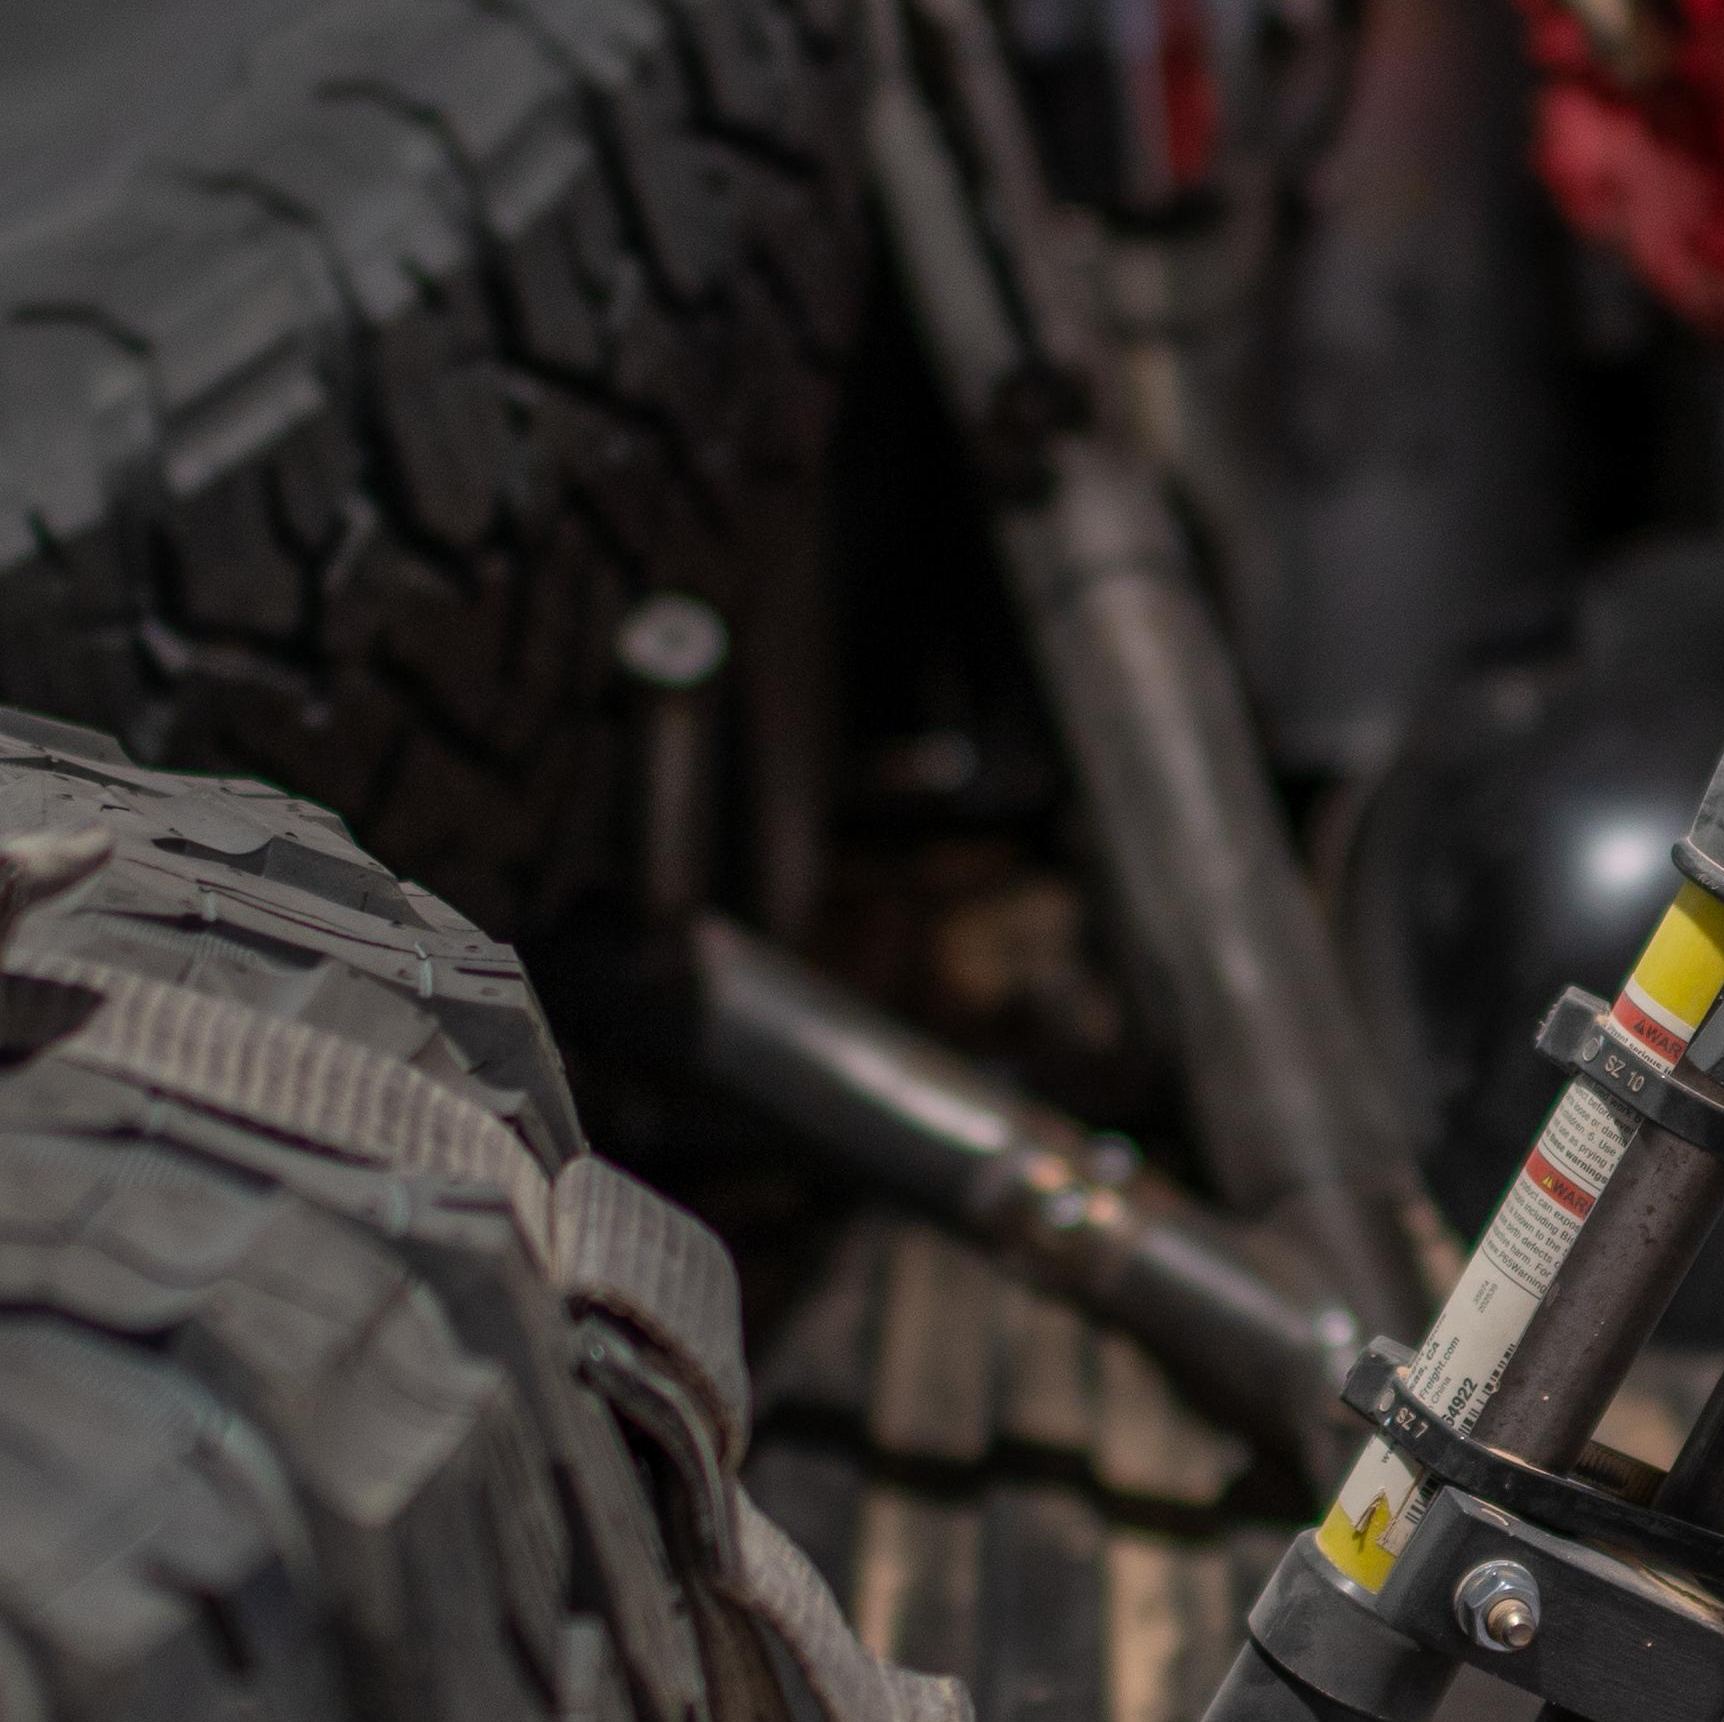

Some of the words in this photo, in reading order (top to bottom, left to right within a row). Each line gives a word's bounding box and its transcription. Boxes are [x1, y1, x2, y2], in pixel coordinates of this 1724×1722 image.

[1604, 1054, 1626, 1078] SZ
[1627, 1072, 1645, 1093] 10
[1578, 1143, 1607, 1167] prying
[1598, 1140, 1616, 1156] Use
[1565, 1149, 1607, 1184] warnings
[1523, 1204, 1558, 1233] including
[1537, 1197, 1553, 1212] can
[1521, 1235, 1553, 1263] defects
[1535, 1229, 1545, 1240] to
[1545, 1237, 1561, 1252] the
[1534, 1263, 1551, 1279] For
[1426, 1341, 1439, 1360] CA
[1419, 1337, 1460, 1400] Freight.com
[1431, 1376, 1451, 1404] China
[1396, 1407, 1417, 1431] SZ
[1415, 1421, 1429, 1438] 7
